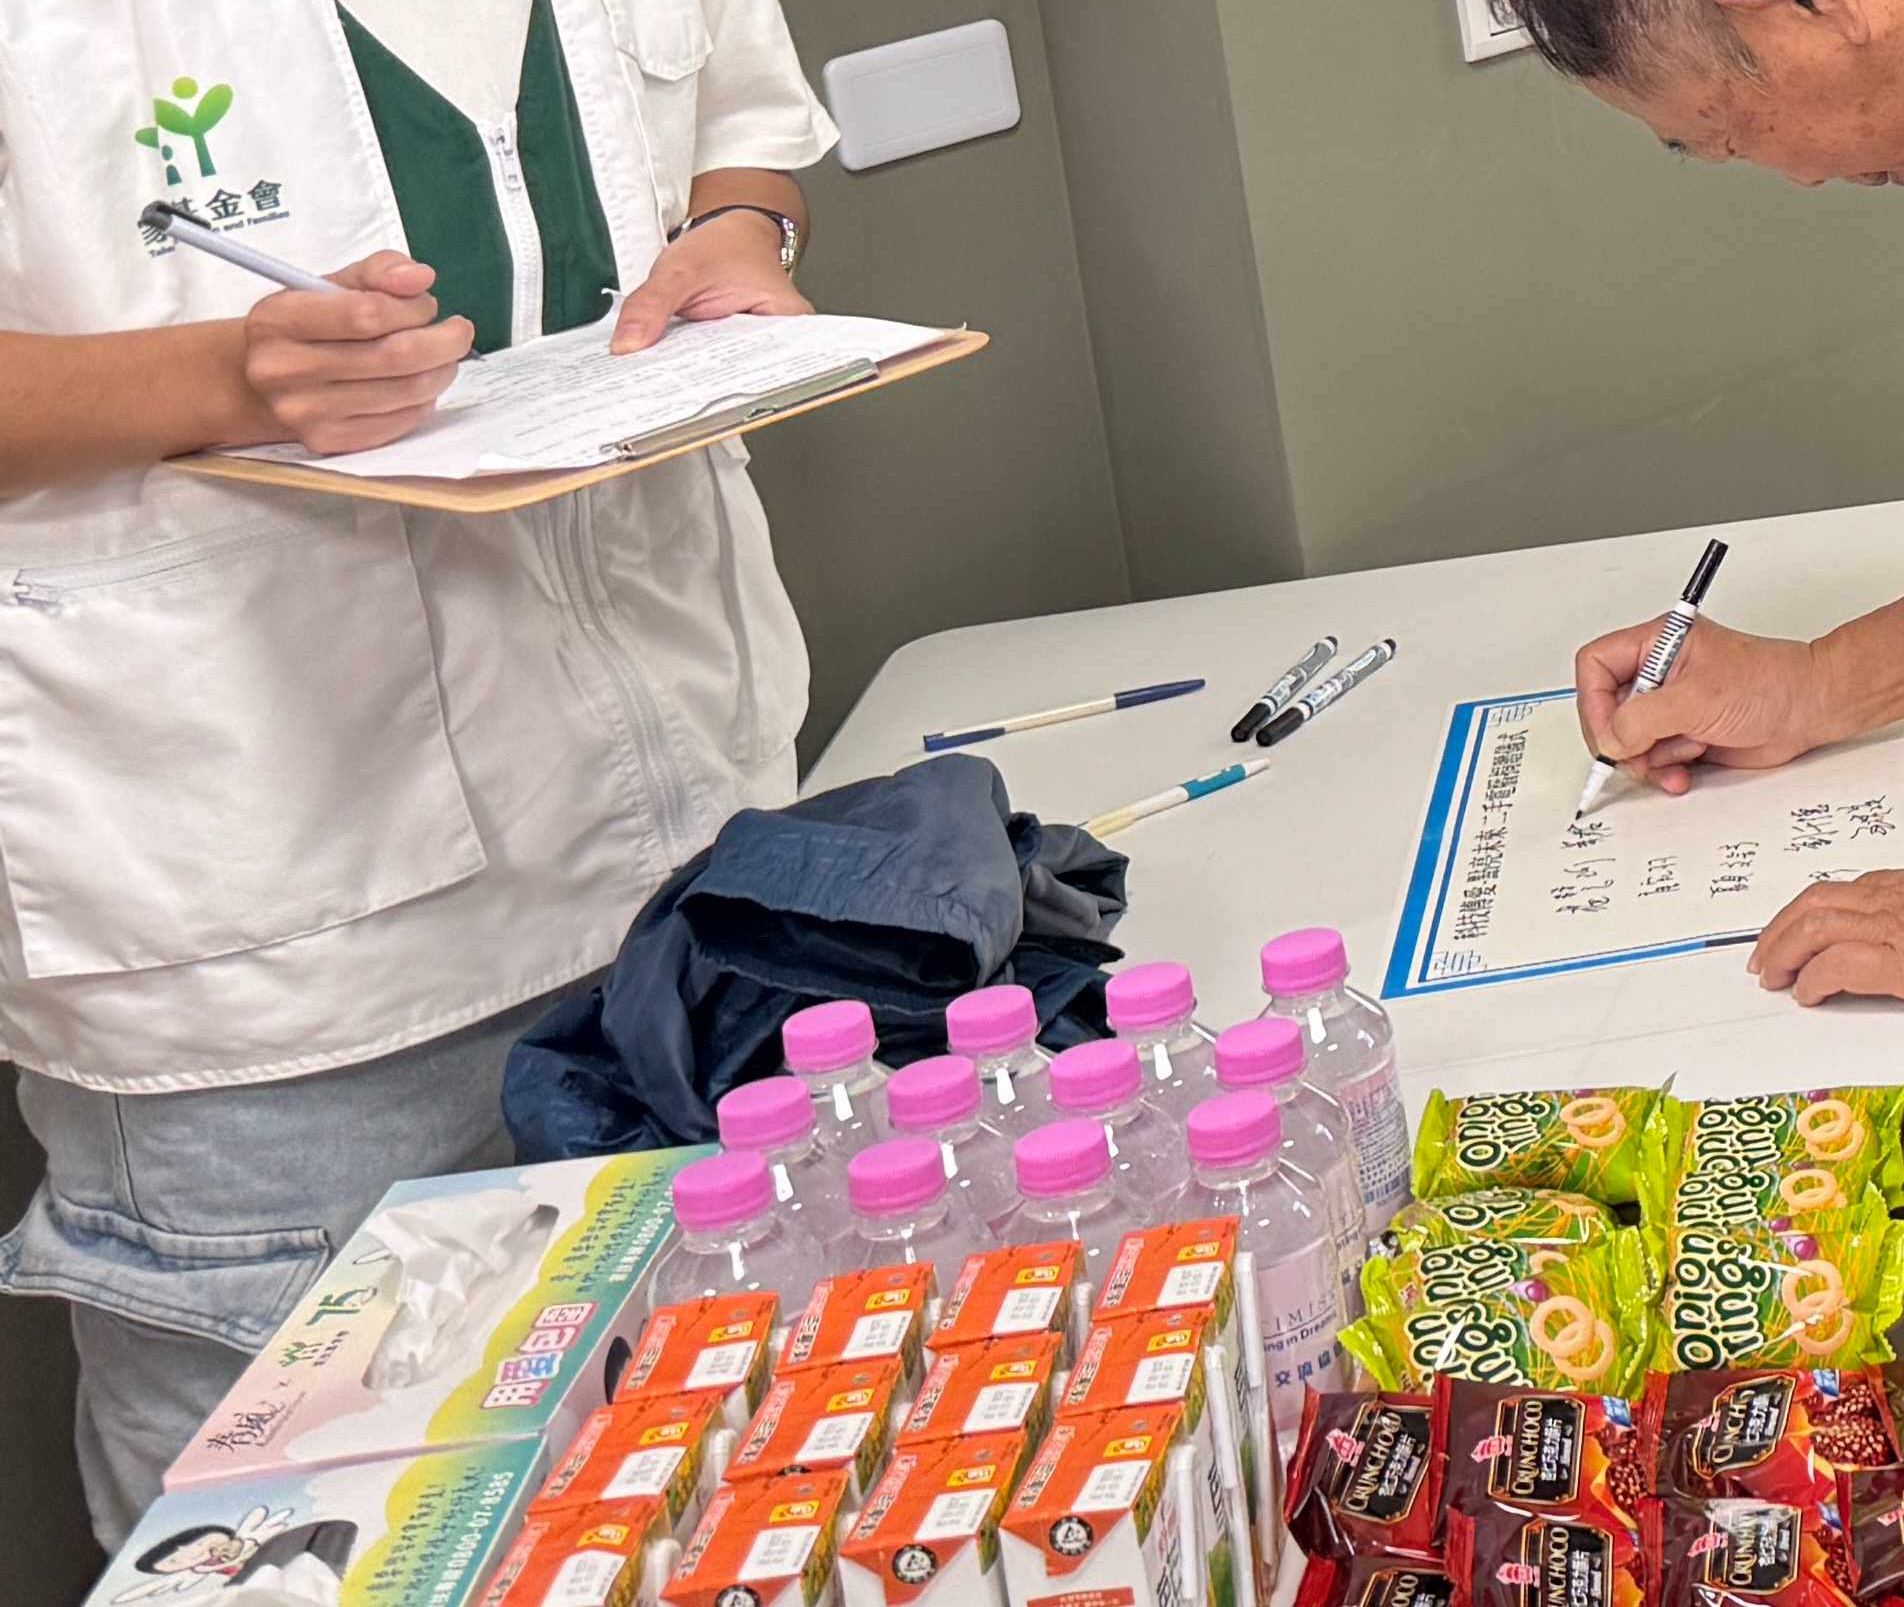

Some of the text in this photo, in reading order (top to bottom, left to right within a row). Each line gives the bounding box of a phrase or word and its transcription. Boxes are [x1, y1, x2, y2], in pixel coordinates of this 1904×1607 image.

[1673, 1231, 1724, 1371] Onion
[1710, 1237, 1771, 1357] rings
[1511, 1399, 1544, 1496] CRUNCHOCO
